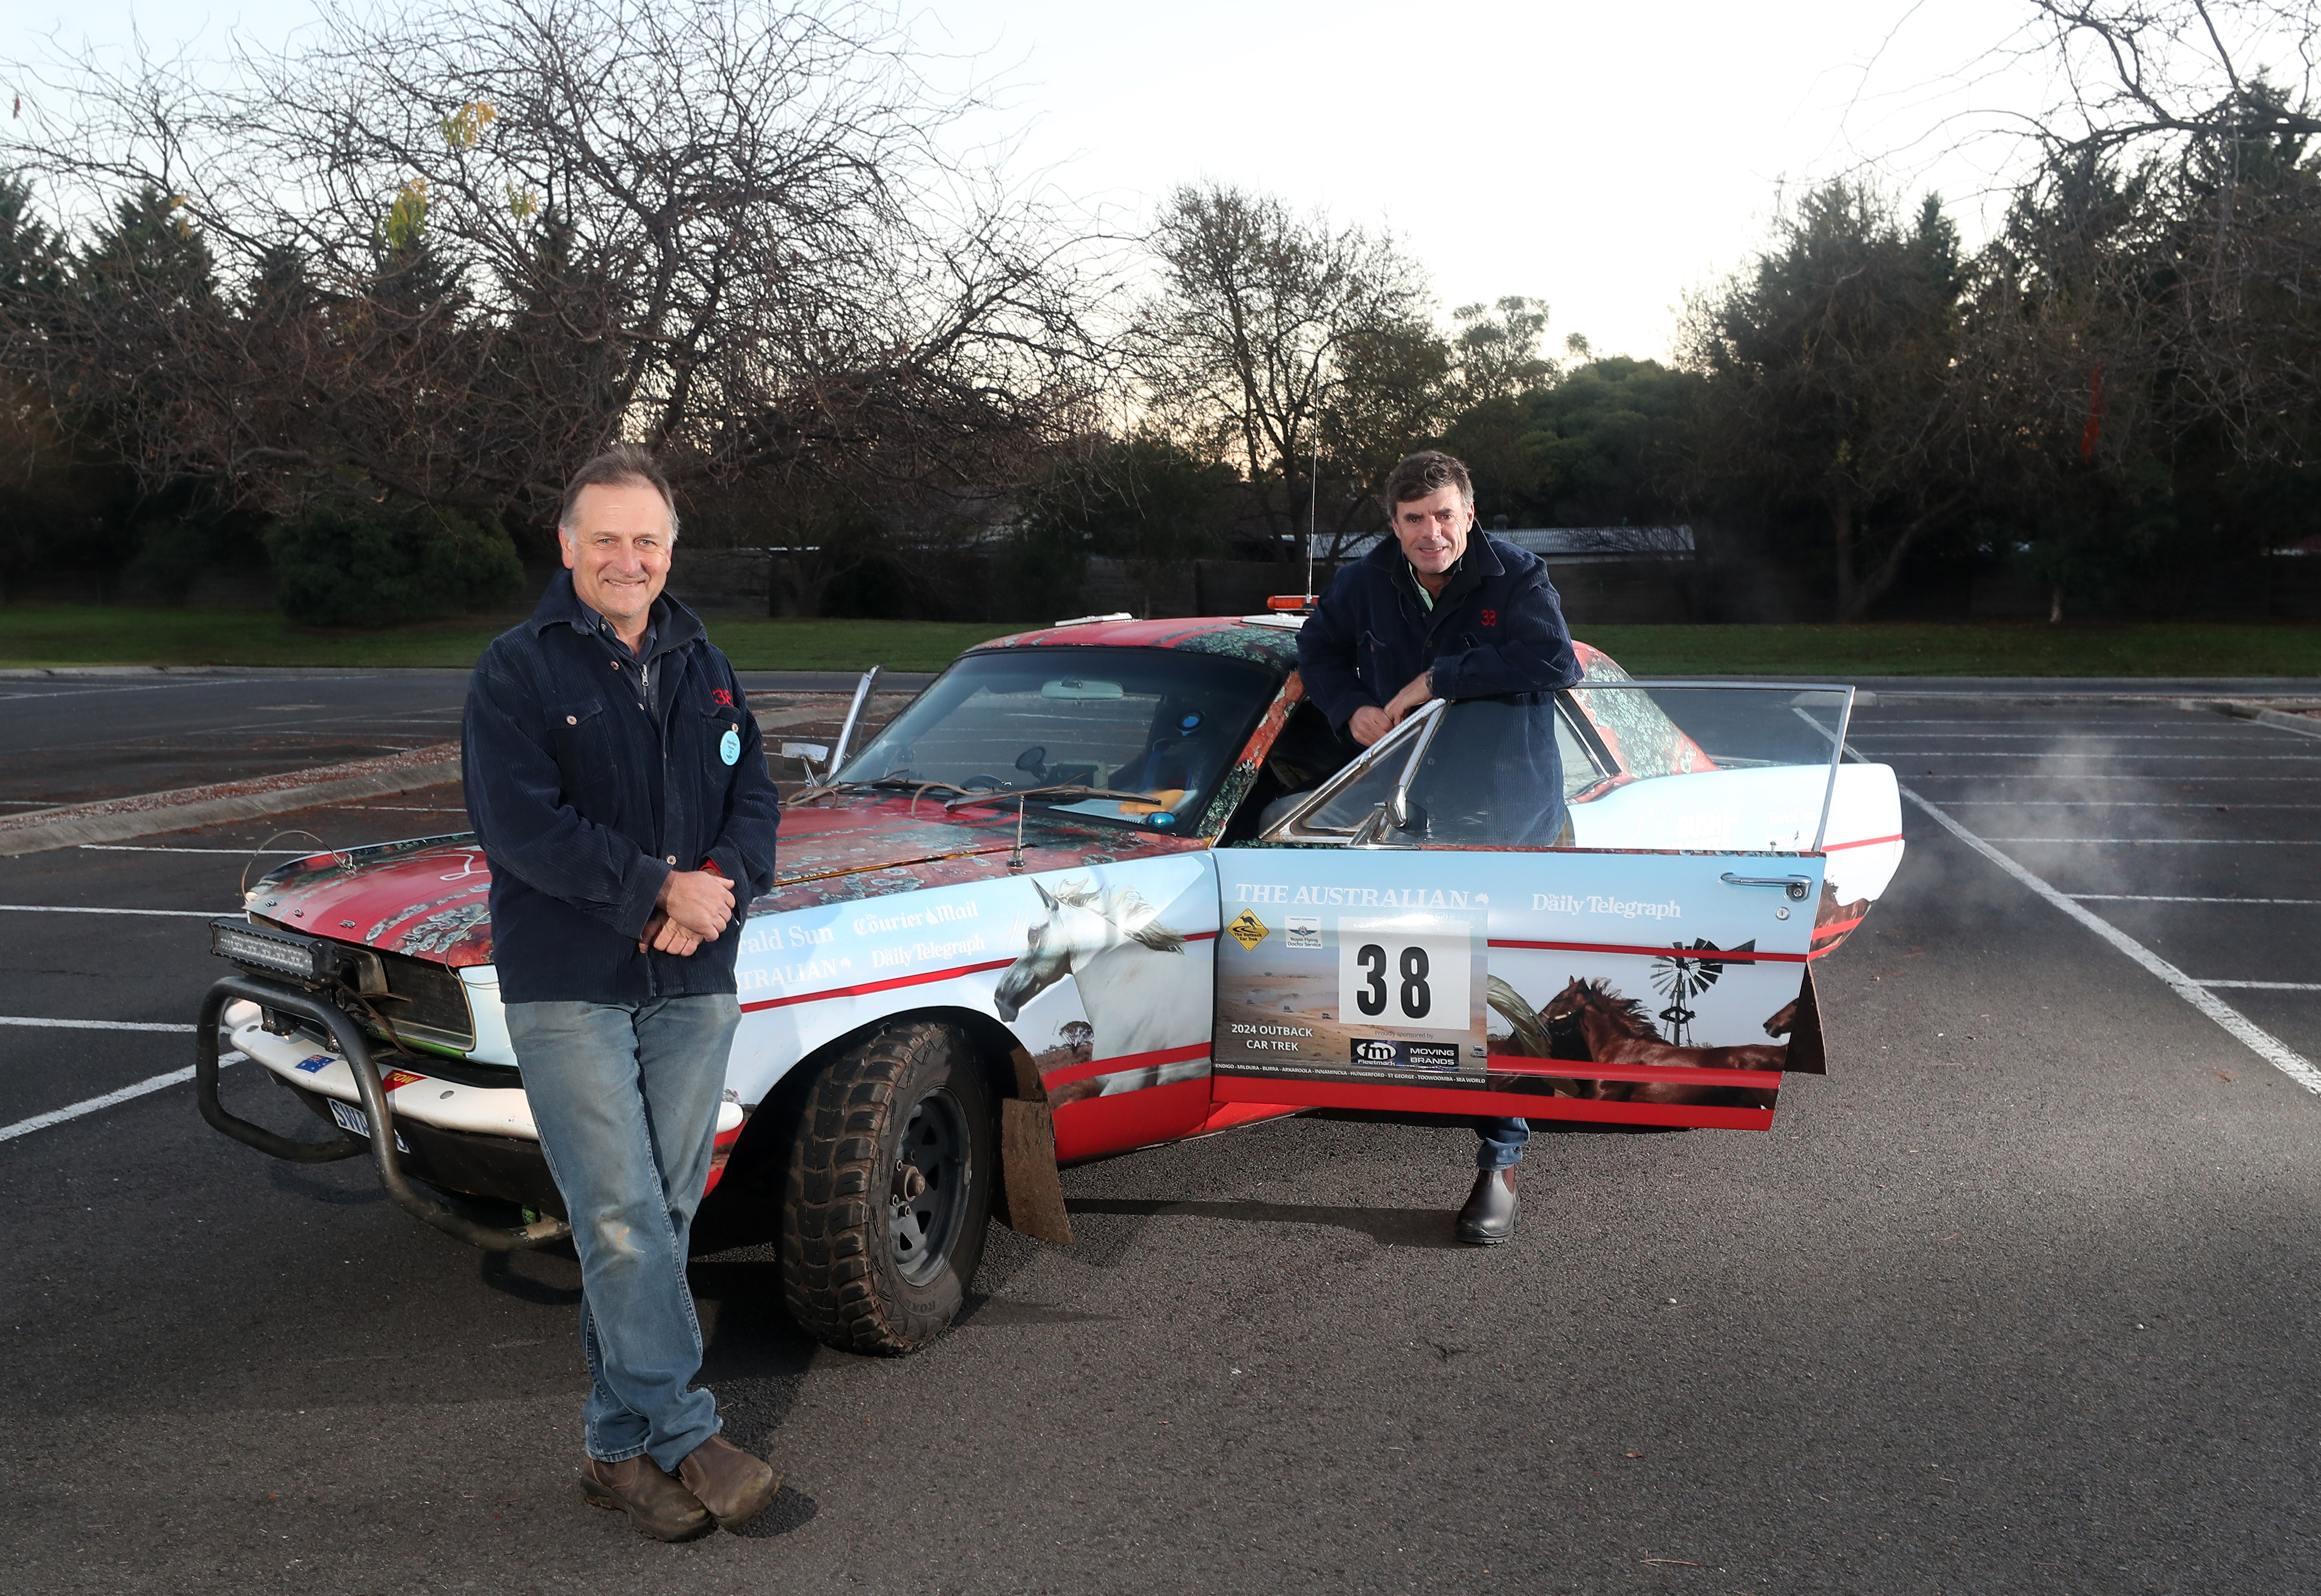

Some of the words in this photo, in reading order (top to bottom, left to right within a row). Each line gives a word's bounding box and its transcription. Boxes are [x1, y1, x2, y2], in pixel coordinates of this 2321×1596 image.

[1481, 609, 1497, 626] 38
[1678, 810, 1722, 840] BUSH
[1768, 809, 1799, 826] Herald
[1800, 808, 1818, 822] Sun
[1236, 883, 1289, 904] THE
[1294, 886, 1470, 909] AUSTRALIAN
[1531, 893, 1585, 916] Daily
[1586, 896, 1682, 921] Telegraph
[853, 912, 925, 936] Courier
[935, 901, 979, 922] Mail
[739, 928, 785, 955] rald
[788, 925, 836, 948] Sun
[871, 947, 913, 967] Daily
[913, 934, 985, 961] Telegraph
[736, 958, 838, 990] TRALIAN
[1356, 944, 1431, 1019] 38
[1231, 1024, 1257, 1034] 2024
[1260, 1026, 1313, 1037] OUTBACK
[1246, 1040, 1269, 1050] CAR
[1271, 1041, 1299, 1051] TREK
[1361, 1042, 1392, 1059] fm
[1410, 1047, 1454, 1056] MOVING
[1410, 1056, 1454, 1065] BRANDS
[387, 1072, 418, 1084] TOW
